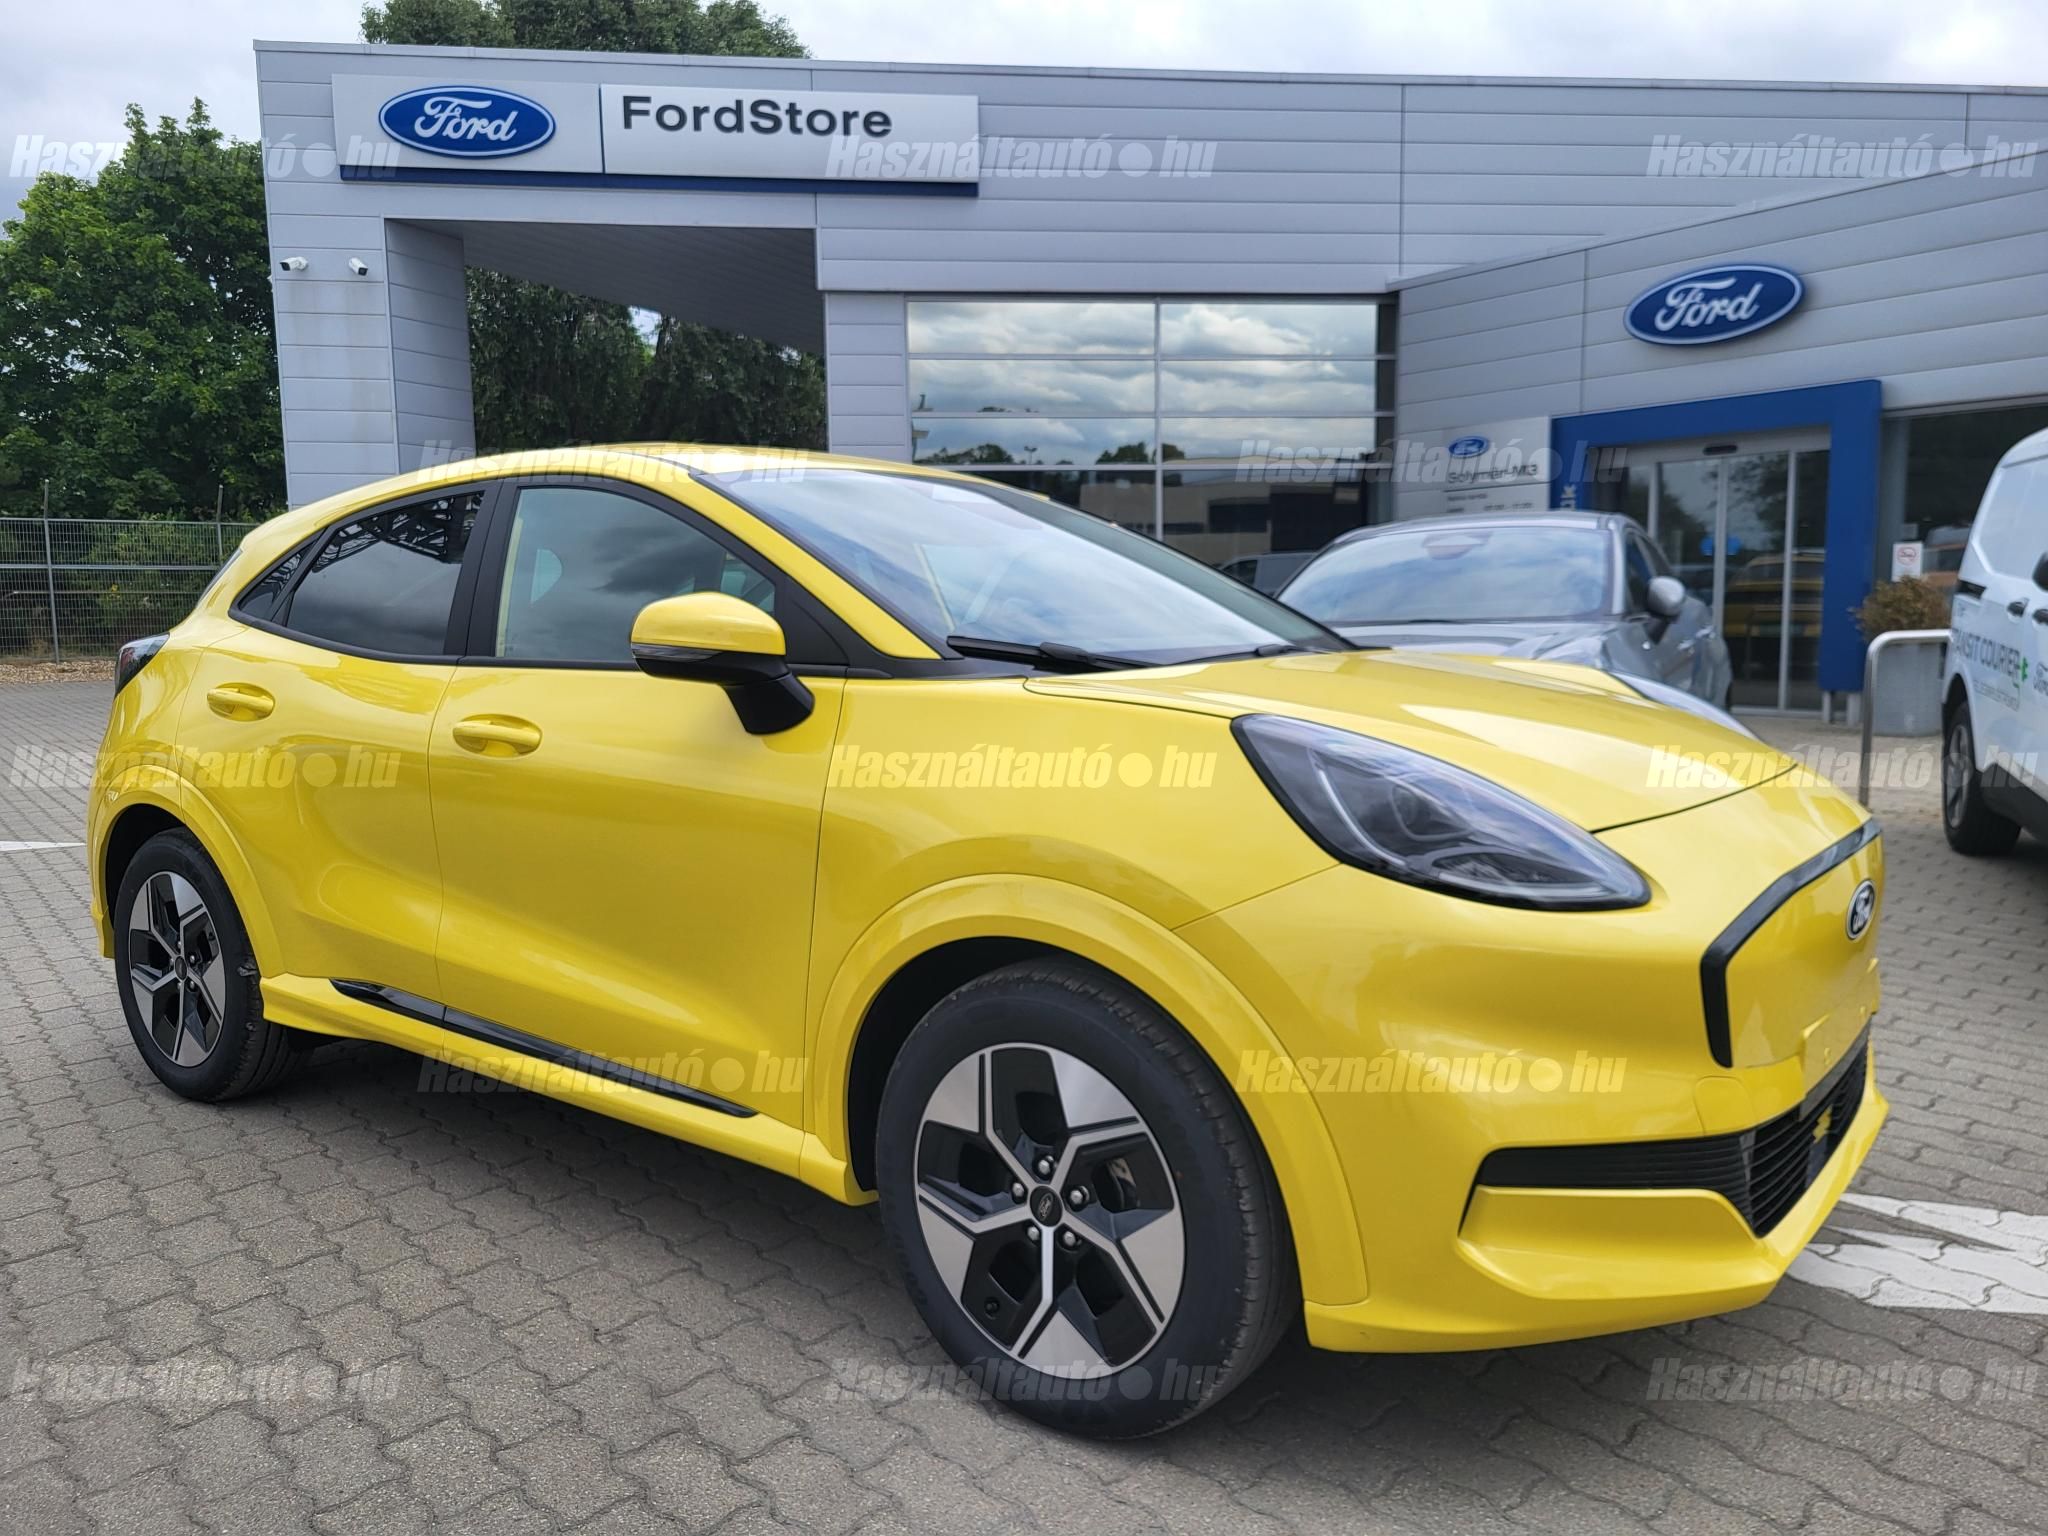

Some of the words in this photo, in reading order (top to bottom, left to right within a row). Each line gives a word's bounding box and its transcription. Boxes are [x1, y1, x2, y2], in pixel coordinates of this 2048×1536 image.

[413, 95, 518, 142] Ford
[622, 95, 892, 138] FordStore
[1653, 276, 1763, 332] Ford
